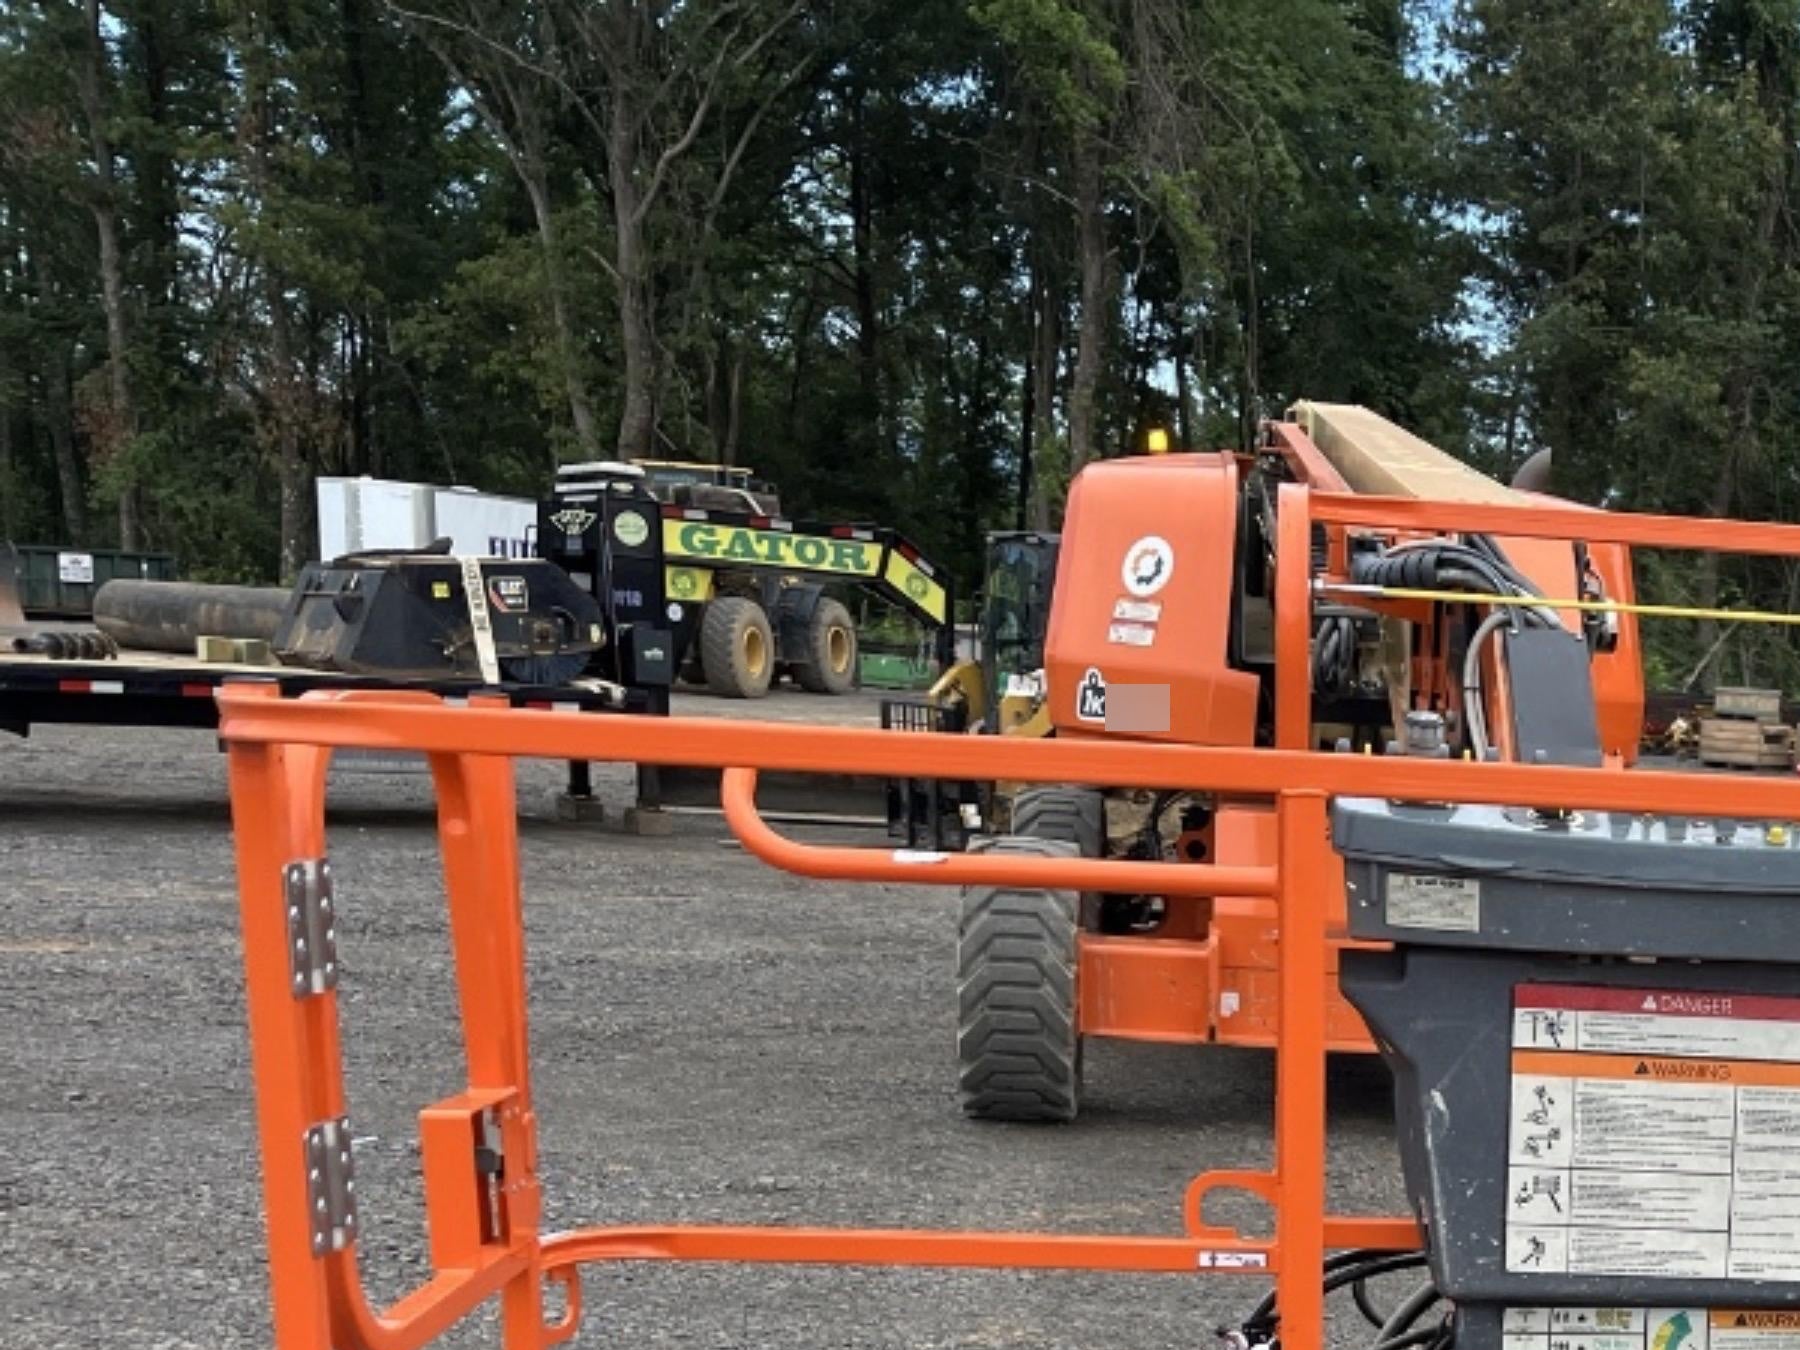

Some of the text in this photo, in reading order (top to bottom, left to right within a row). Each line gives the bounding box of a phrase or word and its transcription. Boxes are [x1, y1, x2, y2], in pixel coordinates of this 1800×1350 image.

[680, 523, 870, 570] GATOR
[1660, 995, 1732, 1015] DANGER
[1652, 1061, 1732, 1080] WARNING
